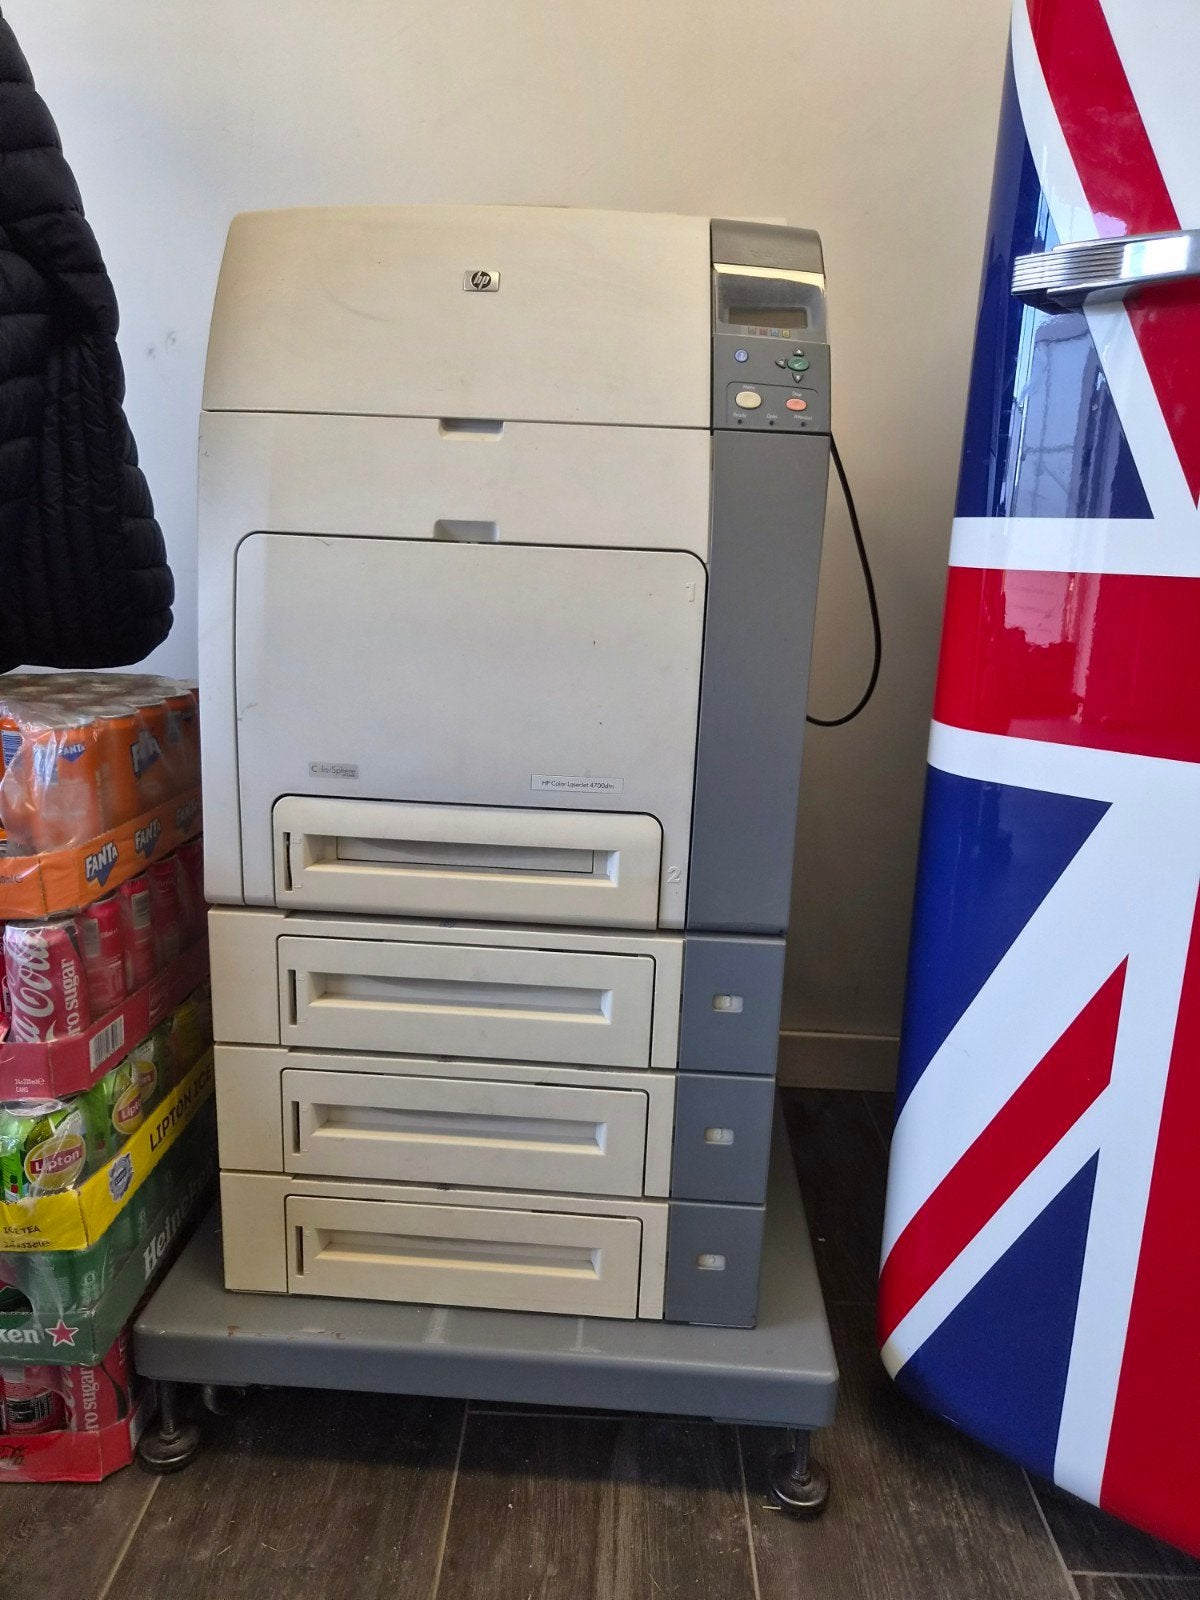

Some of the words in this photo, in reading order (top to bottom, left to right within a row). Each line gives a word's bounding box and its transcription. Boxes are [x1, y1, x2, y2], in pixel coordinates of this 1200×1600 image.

[470, 270, 492, 291] hp
[684, 582, 696, 602] 1
[311, 764, 356, 775] ClorSphere
[134, 819, 161, 852] FANTA
[85, 841, 118, 879] FANTA
[667, 865, 681, 883] 2
[61, 958, 79, 1011] sugar
[66, 1012, 81, 1037] ro
[149, 1089, 192, 1152] LIPTON
[35, 1150, 80, 1172] Lpton
[21, 1226, 41, 1234] TEA
[80, 1367, 99, 1410] sugar
